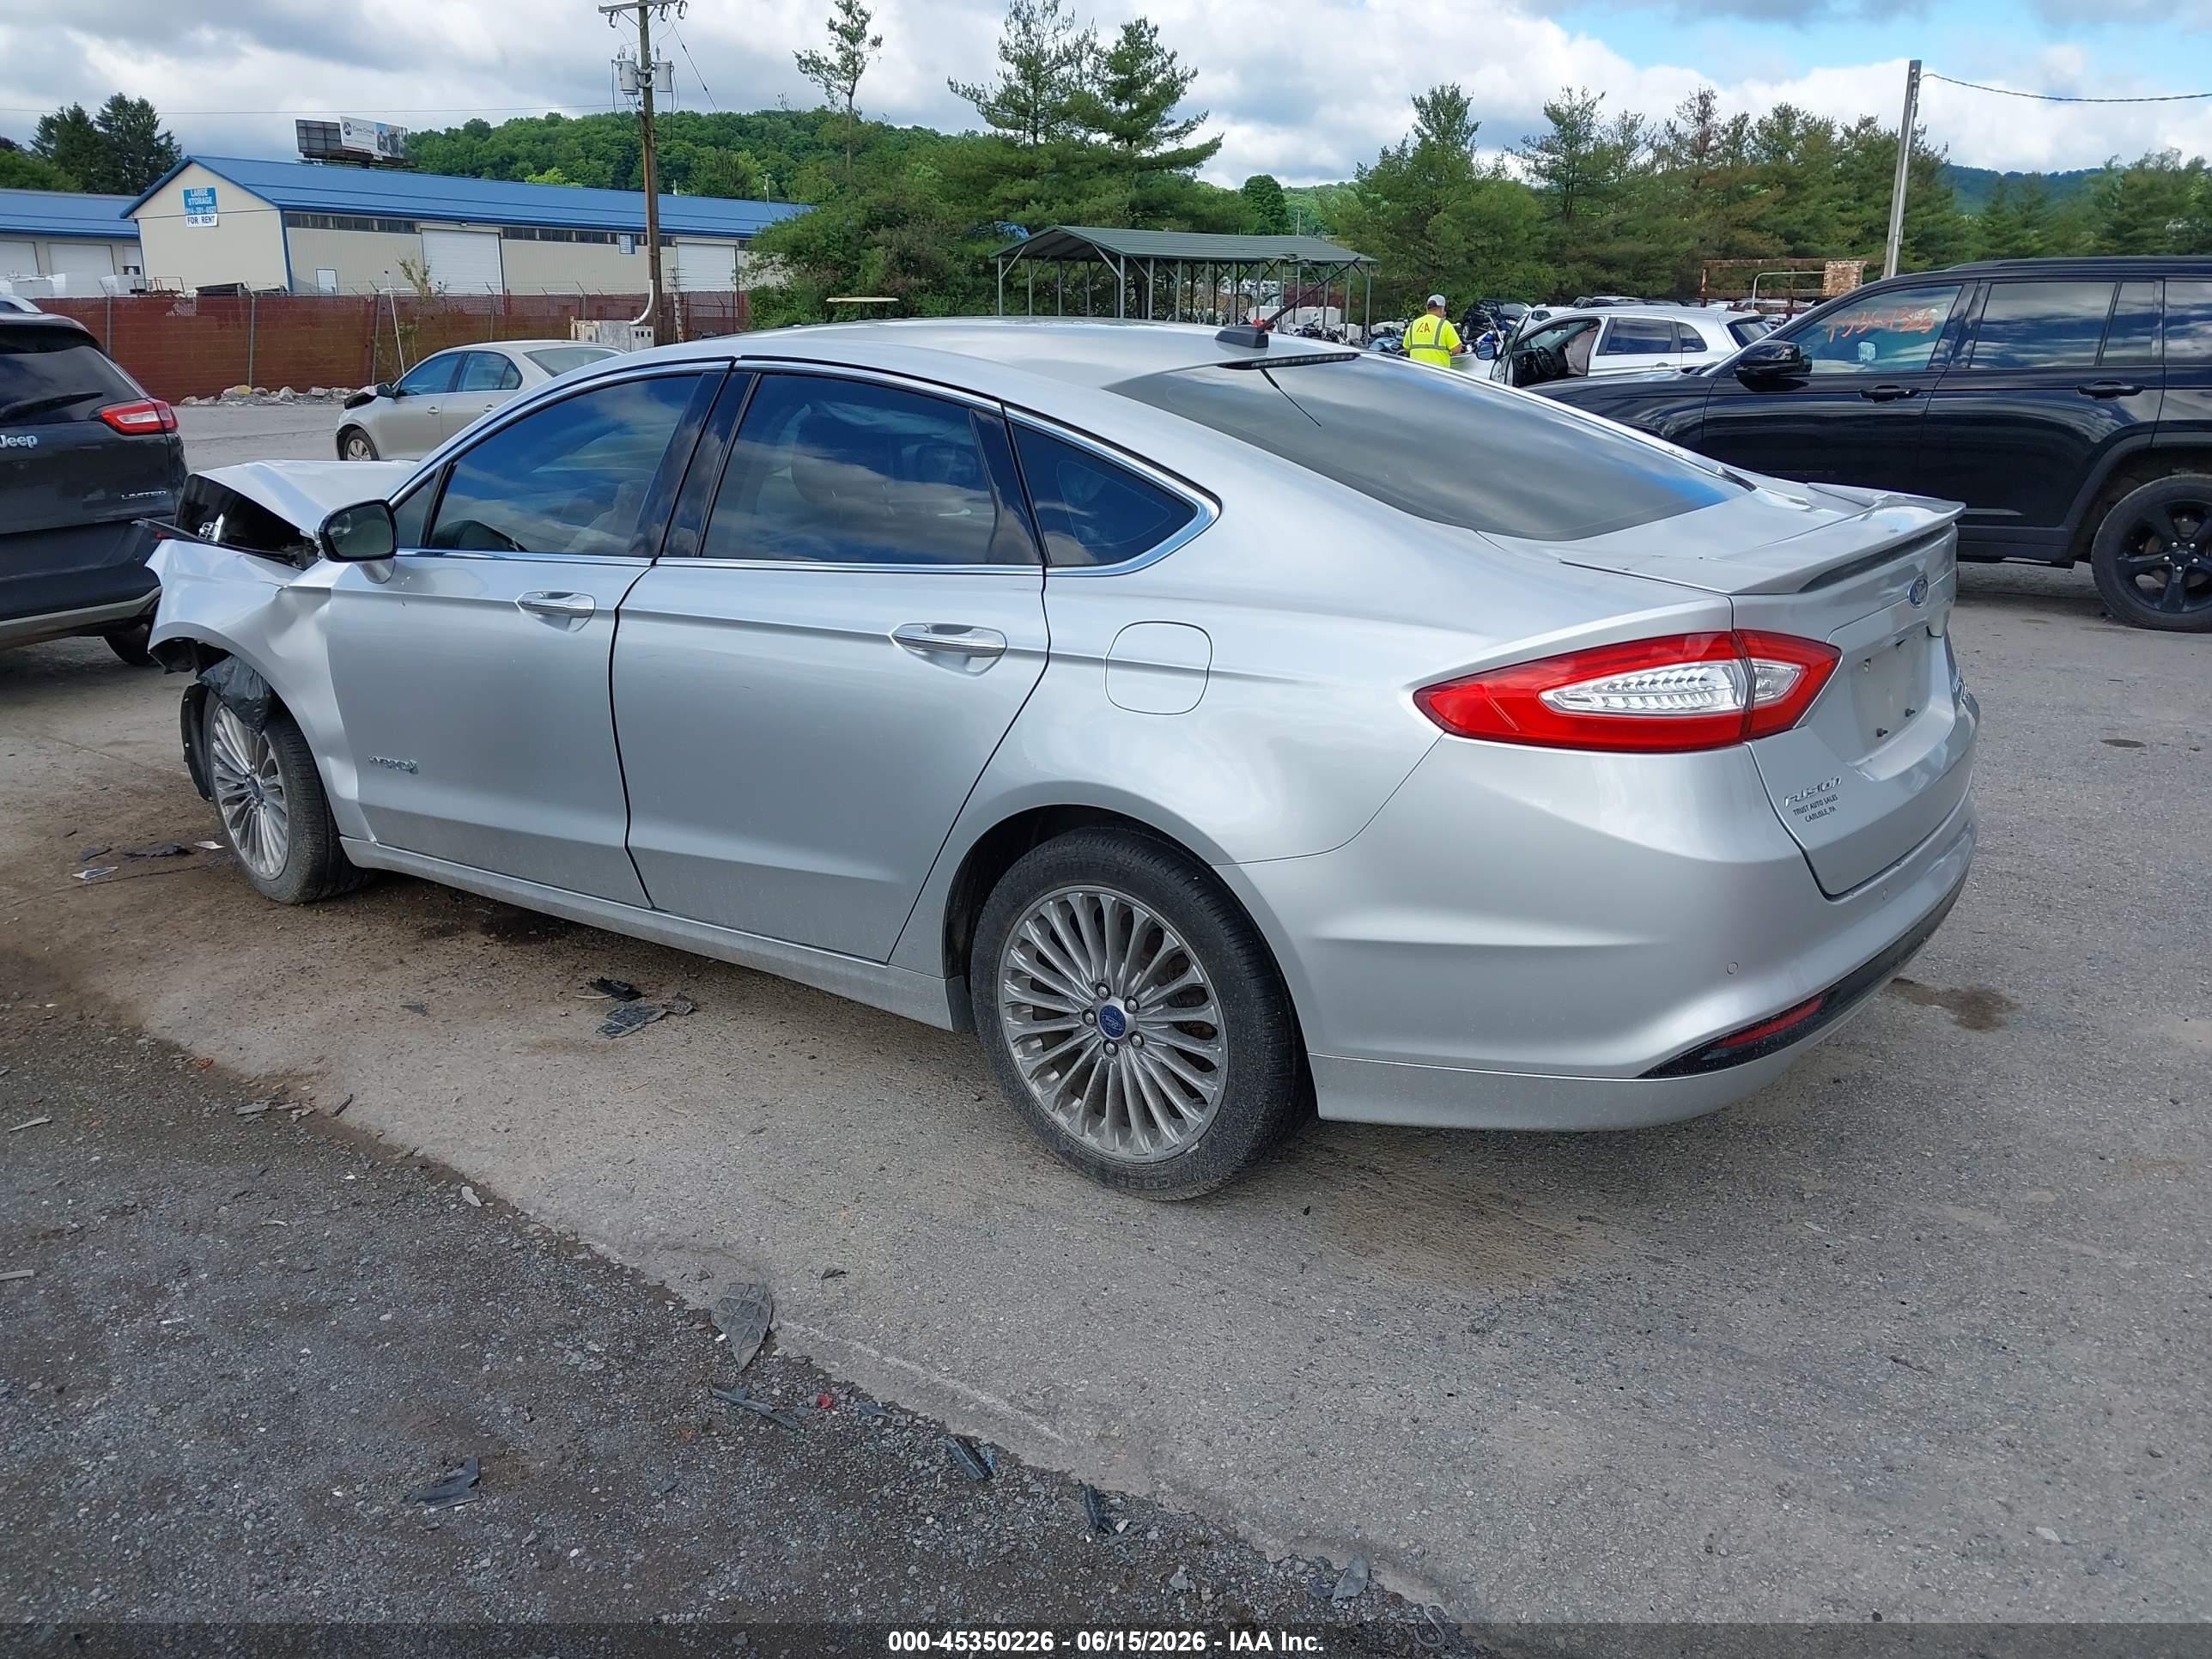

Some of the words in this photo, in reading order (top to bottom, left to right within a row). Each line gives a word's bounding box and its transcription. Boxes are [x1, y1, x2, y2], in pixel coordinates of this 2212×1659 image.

[188, 197, 213, 205] STORAGE
[187, 216, 198, 225] FOR
[201, 216, 216, 224] RENT
[0, 434, 38, 448] Jeep
[1793, 804, 1809, 817] TRUST
[1809, 799, 1824, 810] AUTO
[1823, 793, 1838, 805] SALES
